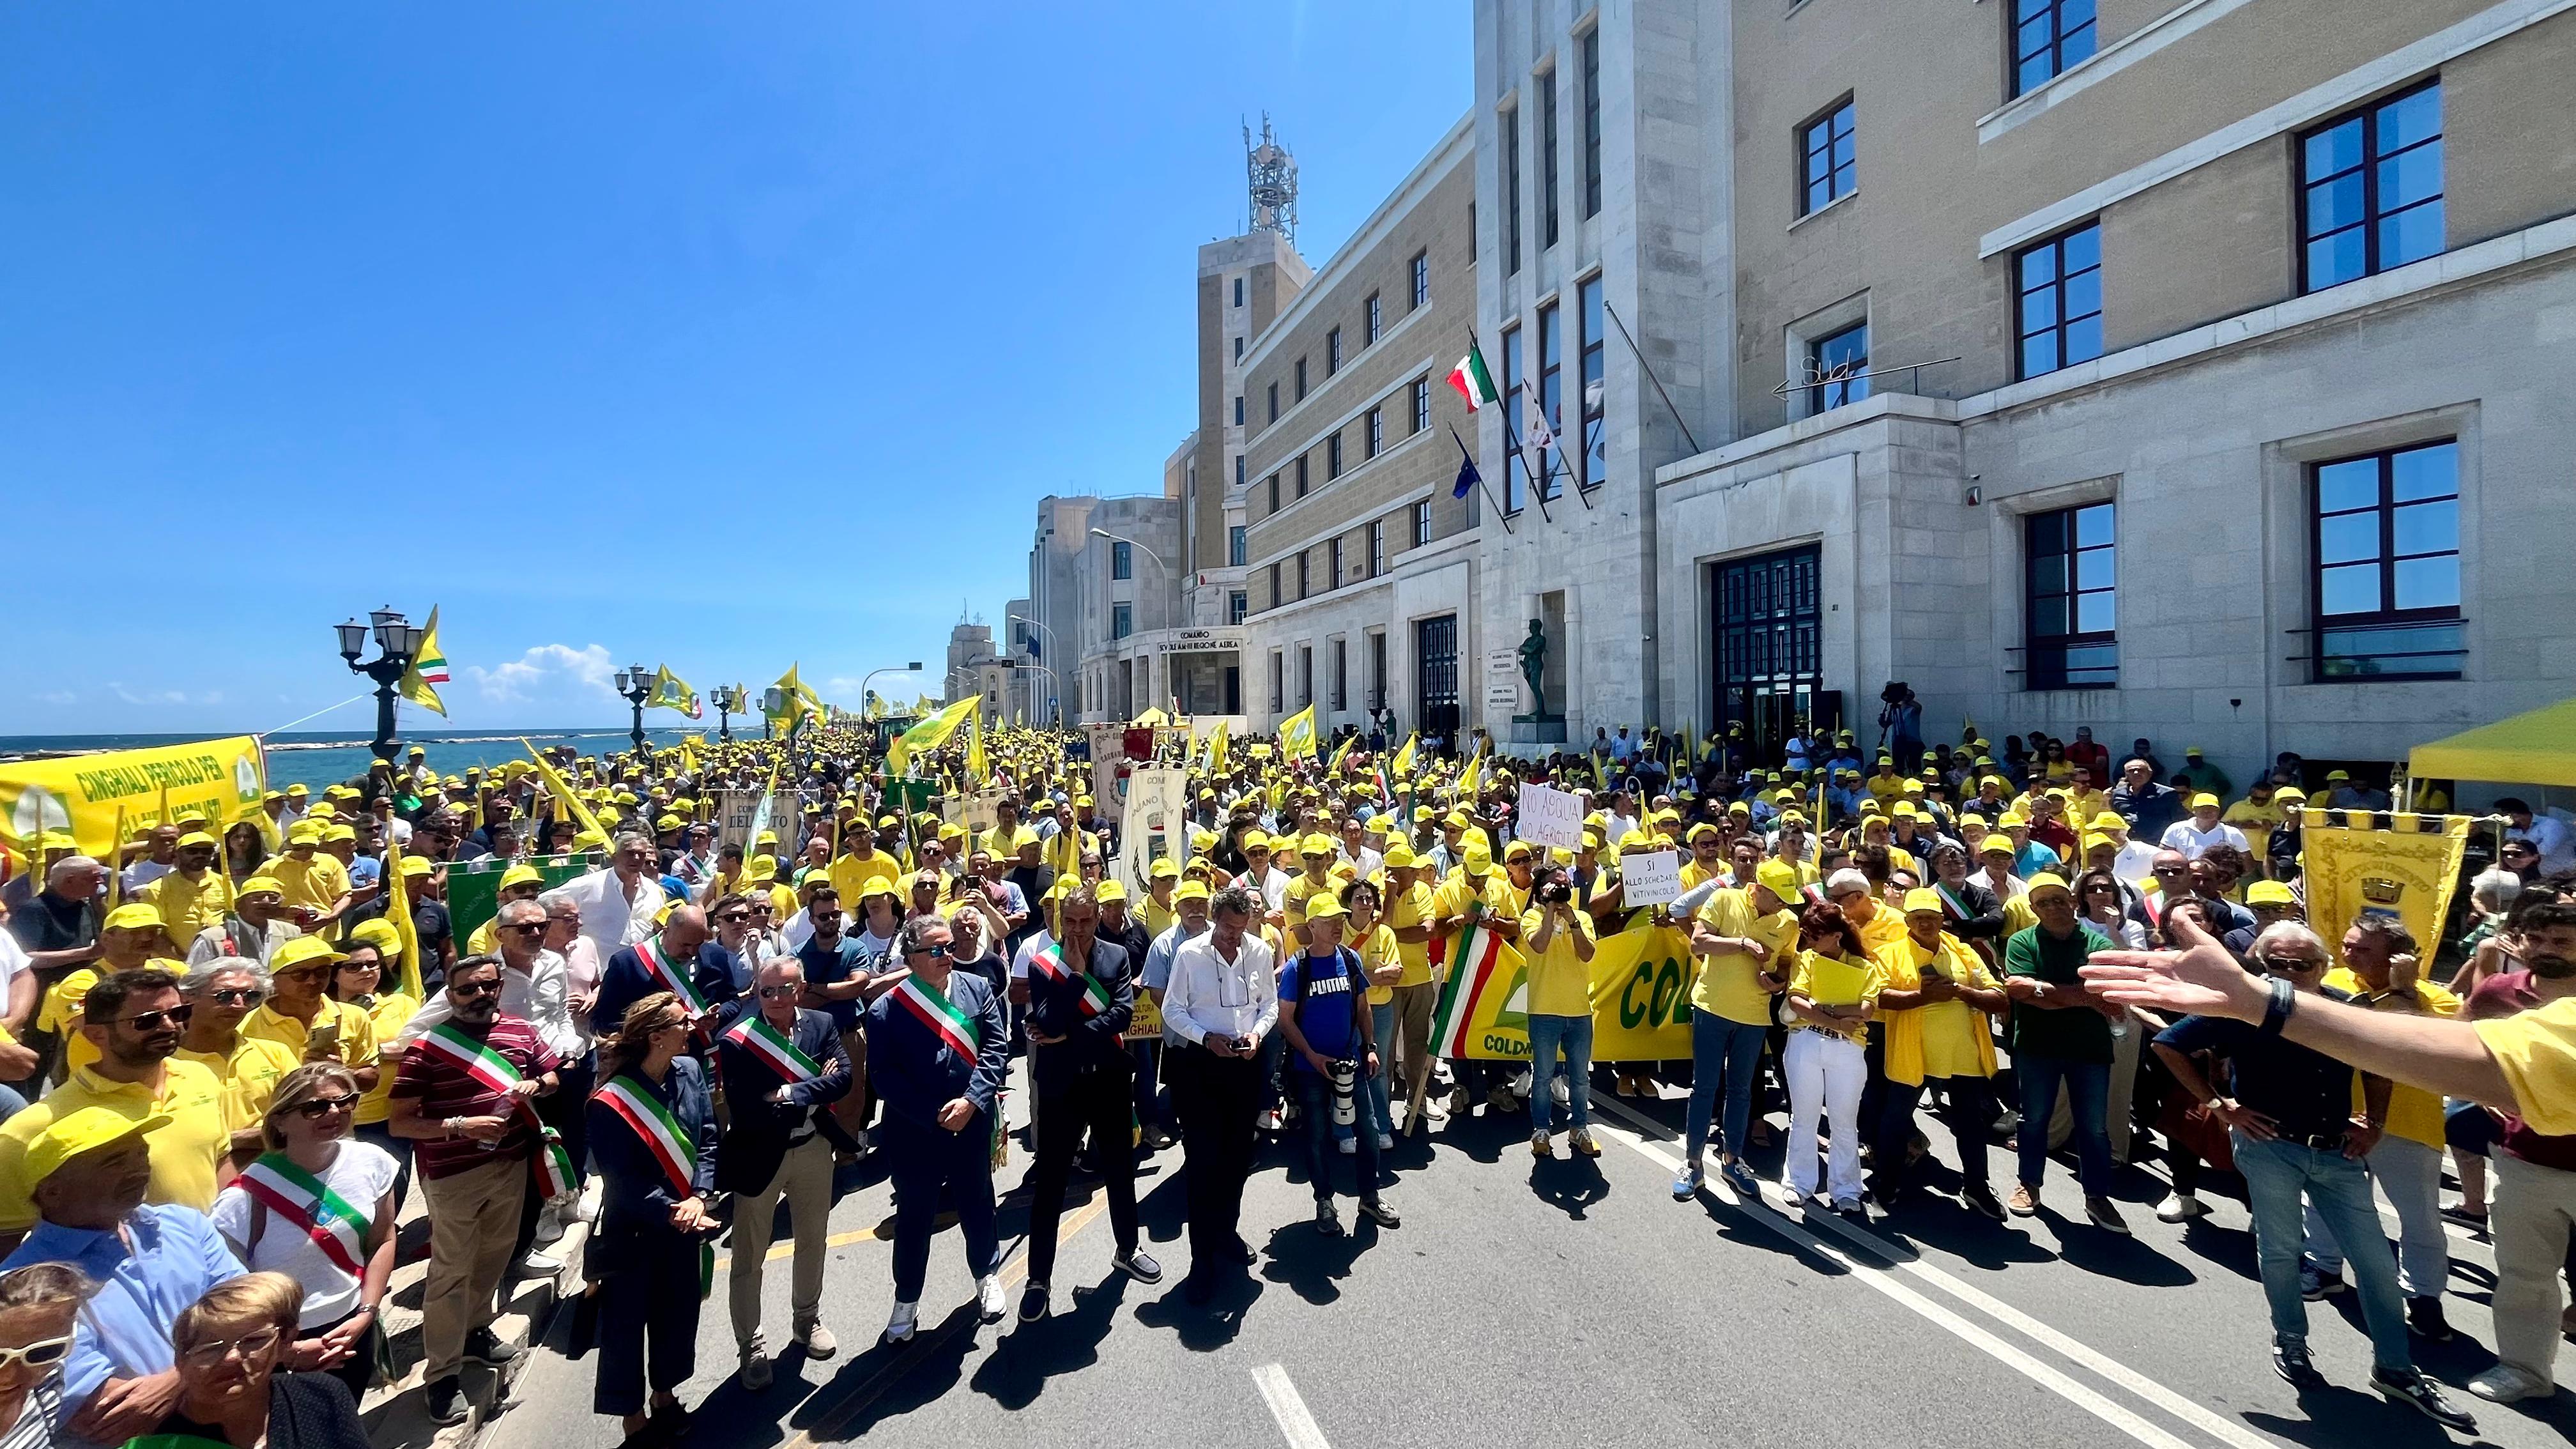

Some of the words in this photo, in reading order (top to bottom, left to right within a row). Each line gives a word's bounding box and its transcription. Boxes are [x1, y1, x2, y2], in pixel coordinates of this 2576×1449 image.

[1800, 348, 1851, 385] Sud
[75, 765, 151, 802] CINGHIALI
[141, 756, 204, 791] PERICOLO
[195, 755, 225, 781] PER
[1522, 787, 1537, 813] NO
[1521, 821, 1533, 838] NO
[1625, 877, 1642, 886] ALLO
[1644, 873, 1679, 885] SCHEDARIO
[1632, 887, 1675, 898] VITIVINICOLO
[1310, 976, 1349, 996] PUMA
